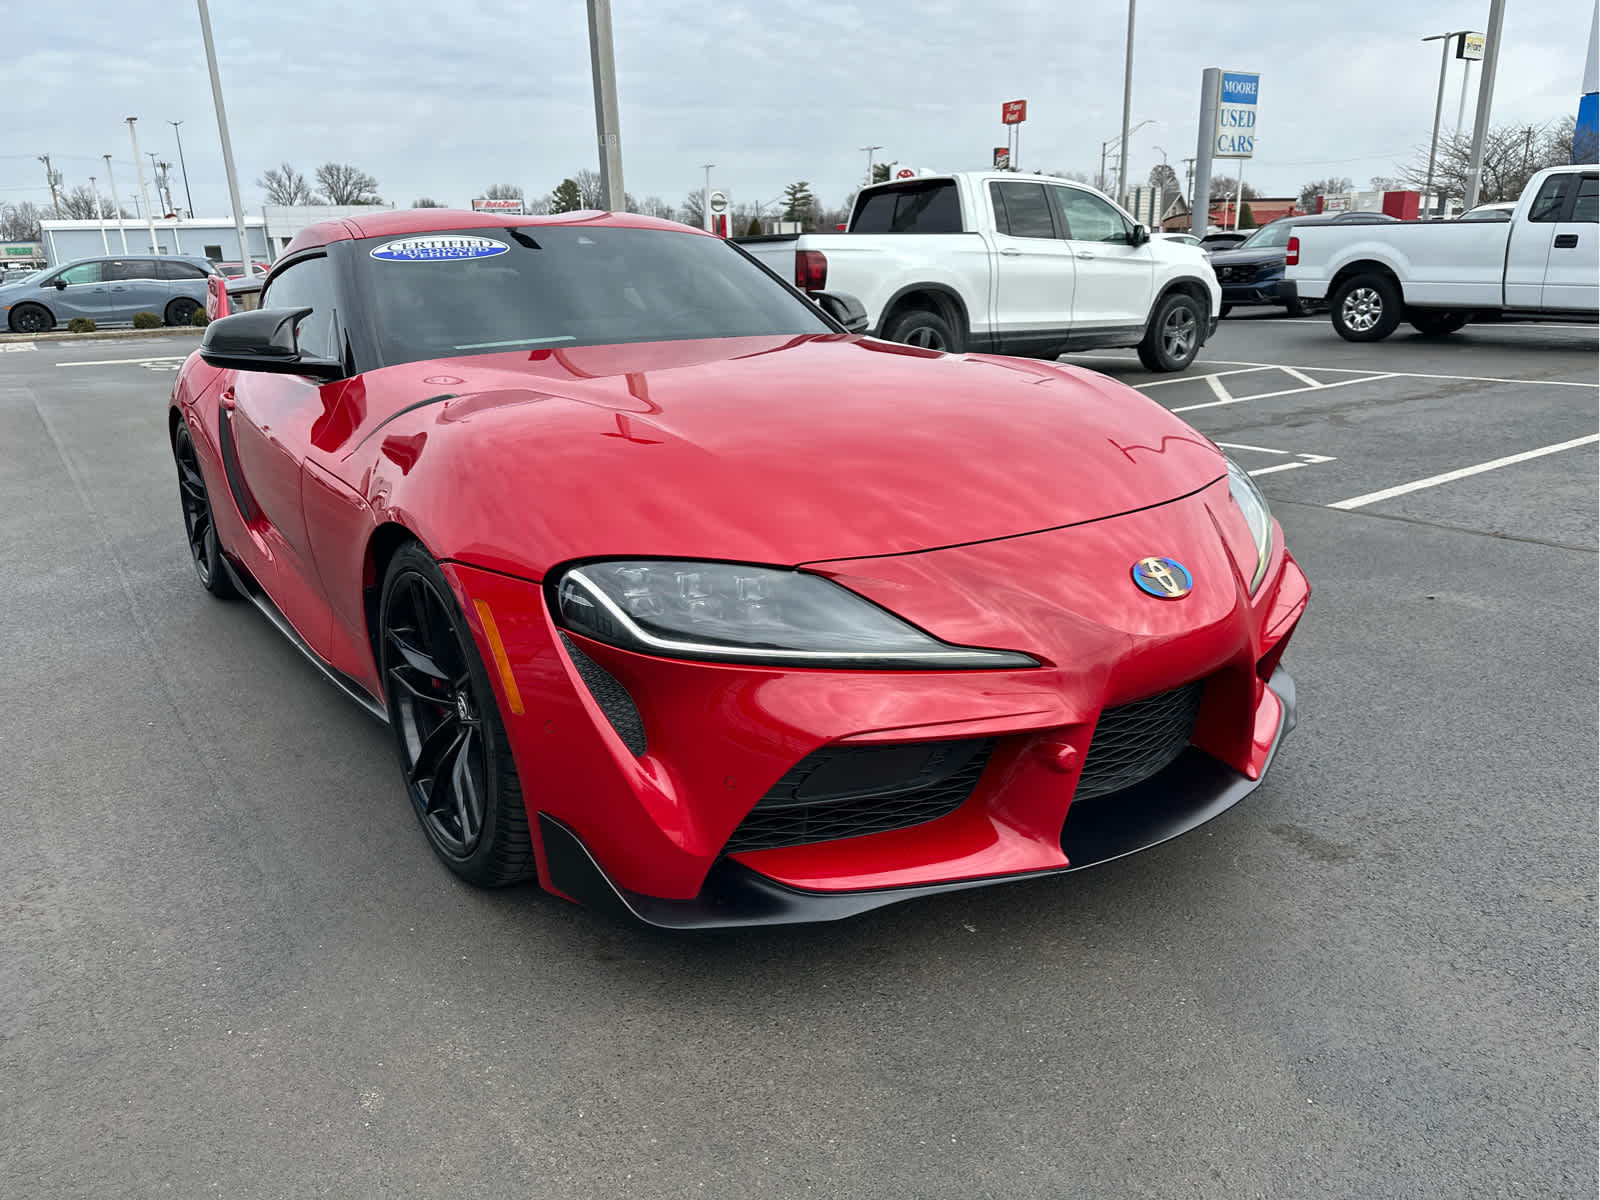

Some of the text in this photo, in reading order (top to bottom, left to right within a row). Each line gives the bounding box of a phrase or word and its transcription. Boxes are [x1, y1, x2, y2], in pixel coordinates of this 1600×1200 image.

[1223, 80, 1257, 95] MOORE
[1220, 109, 1256, 128] USED
[1217, 134, 1254, 152] CARS
[485, 200, 519, 208] AutoZone
[387, 240, 494, 250] CERTIFIED
[392, 246, 490, 256] PRE-OWNED
[408, 248, 477, 259] VEHICLE
